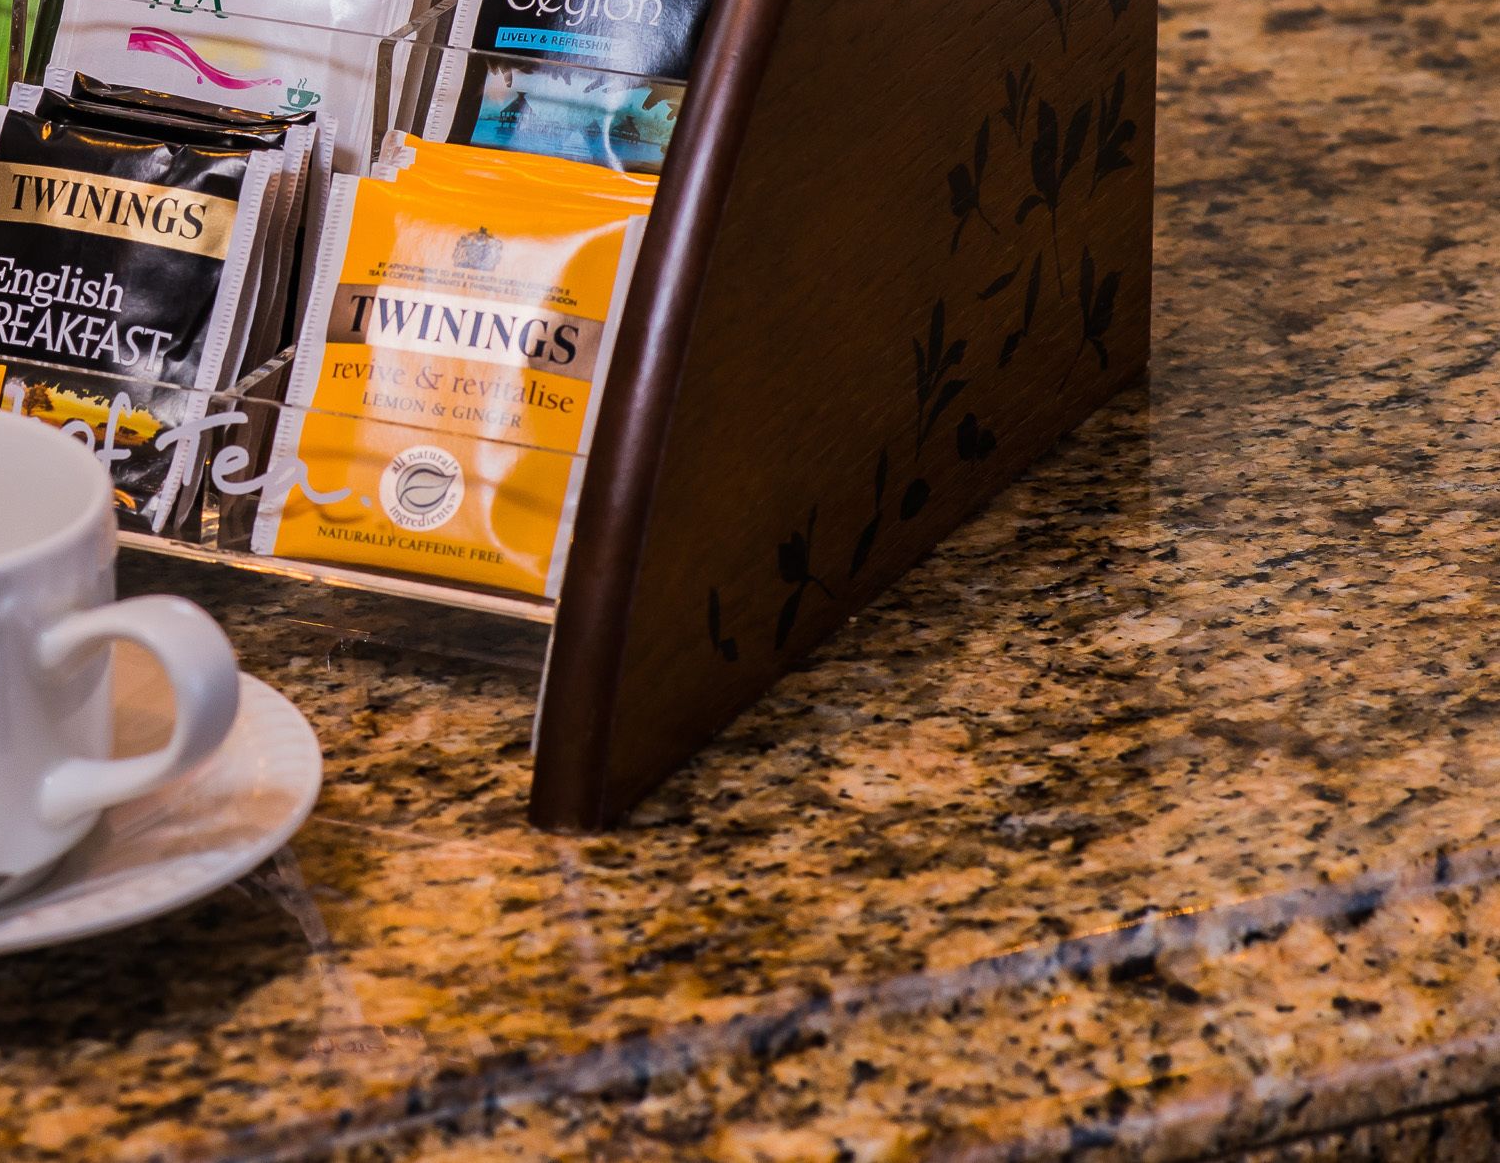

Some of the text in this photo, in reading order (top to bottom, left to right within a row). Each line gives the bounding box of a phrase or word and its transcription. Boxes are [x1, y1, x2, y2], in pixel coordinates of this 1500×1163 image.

[501, 32, 613, 52] LIVELY & REFRESHIN
[11, 173, 207, 240] TWININGS
[349, 294, 580, 366] TWININGS
[331, 358, 574, 414] revive & revitalise
[362, 391, 522, 430] LEMON & GINGER
[392, 456, 406, 475] all
[317, 524, 505, 565] NATURALLY CAFFEINE FREE
